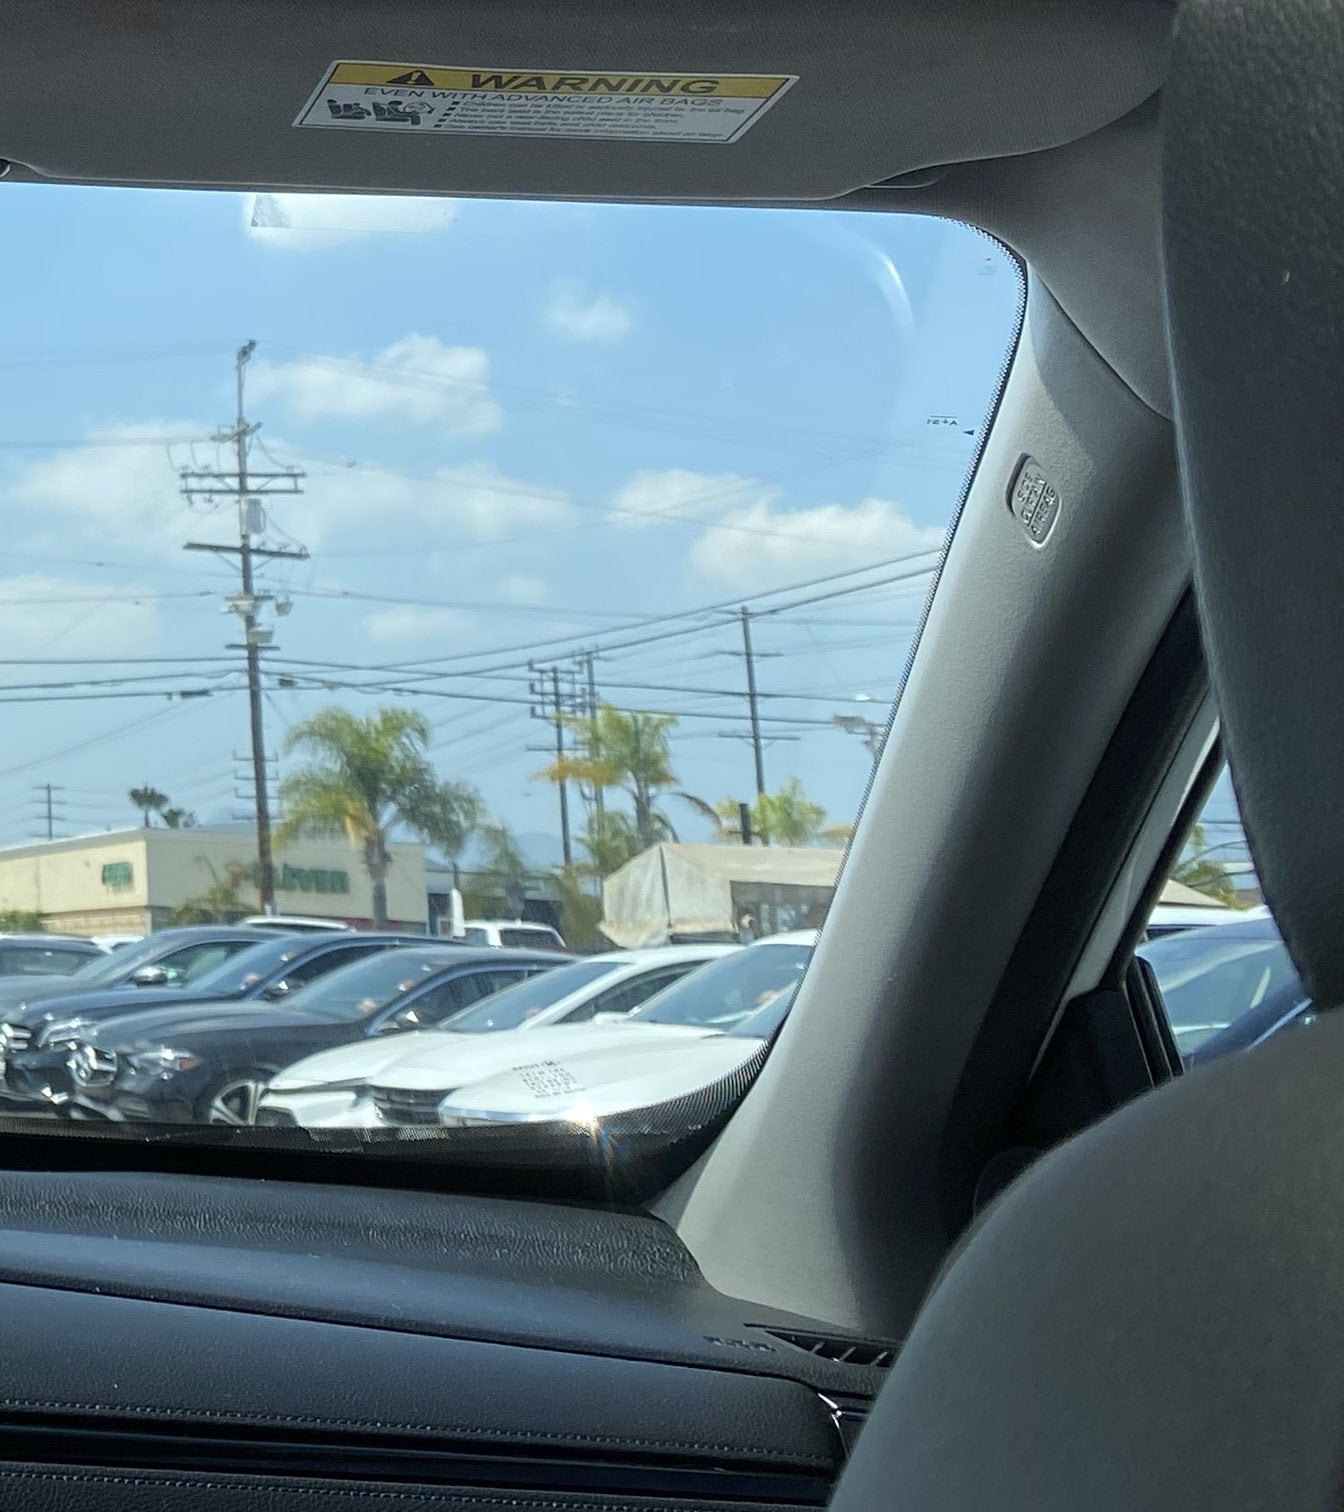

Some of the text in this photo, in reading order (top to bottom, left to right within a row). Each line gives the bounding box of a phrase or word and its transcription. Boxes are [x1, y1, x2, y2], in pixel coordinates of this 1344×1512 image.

[471, 74, 720, 94] WARNING
[364, 88, 724, 106] EVEN WITH ADVANCED AIR BAGS
[1017, 472, 1034, 503] SIDE
[1031, 486, 1056, 536] AIRBAG
